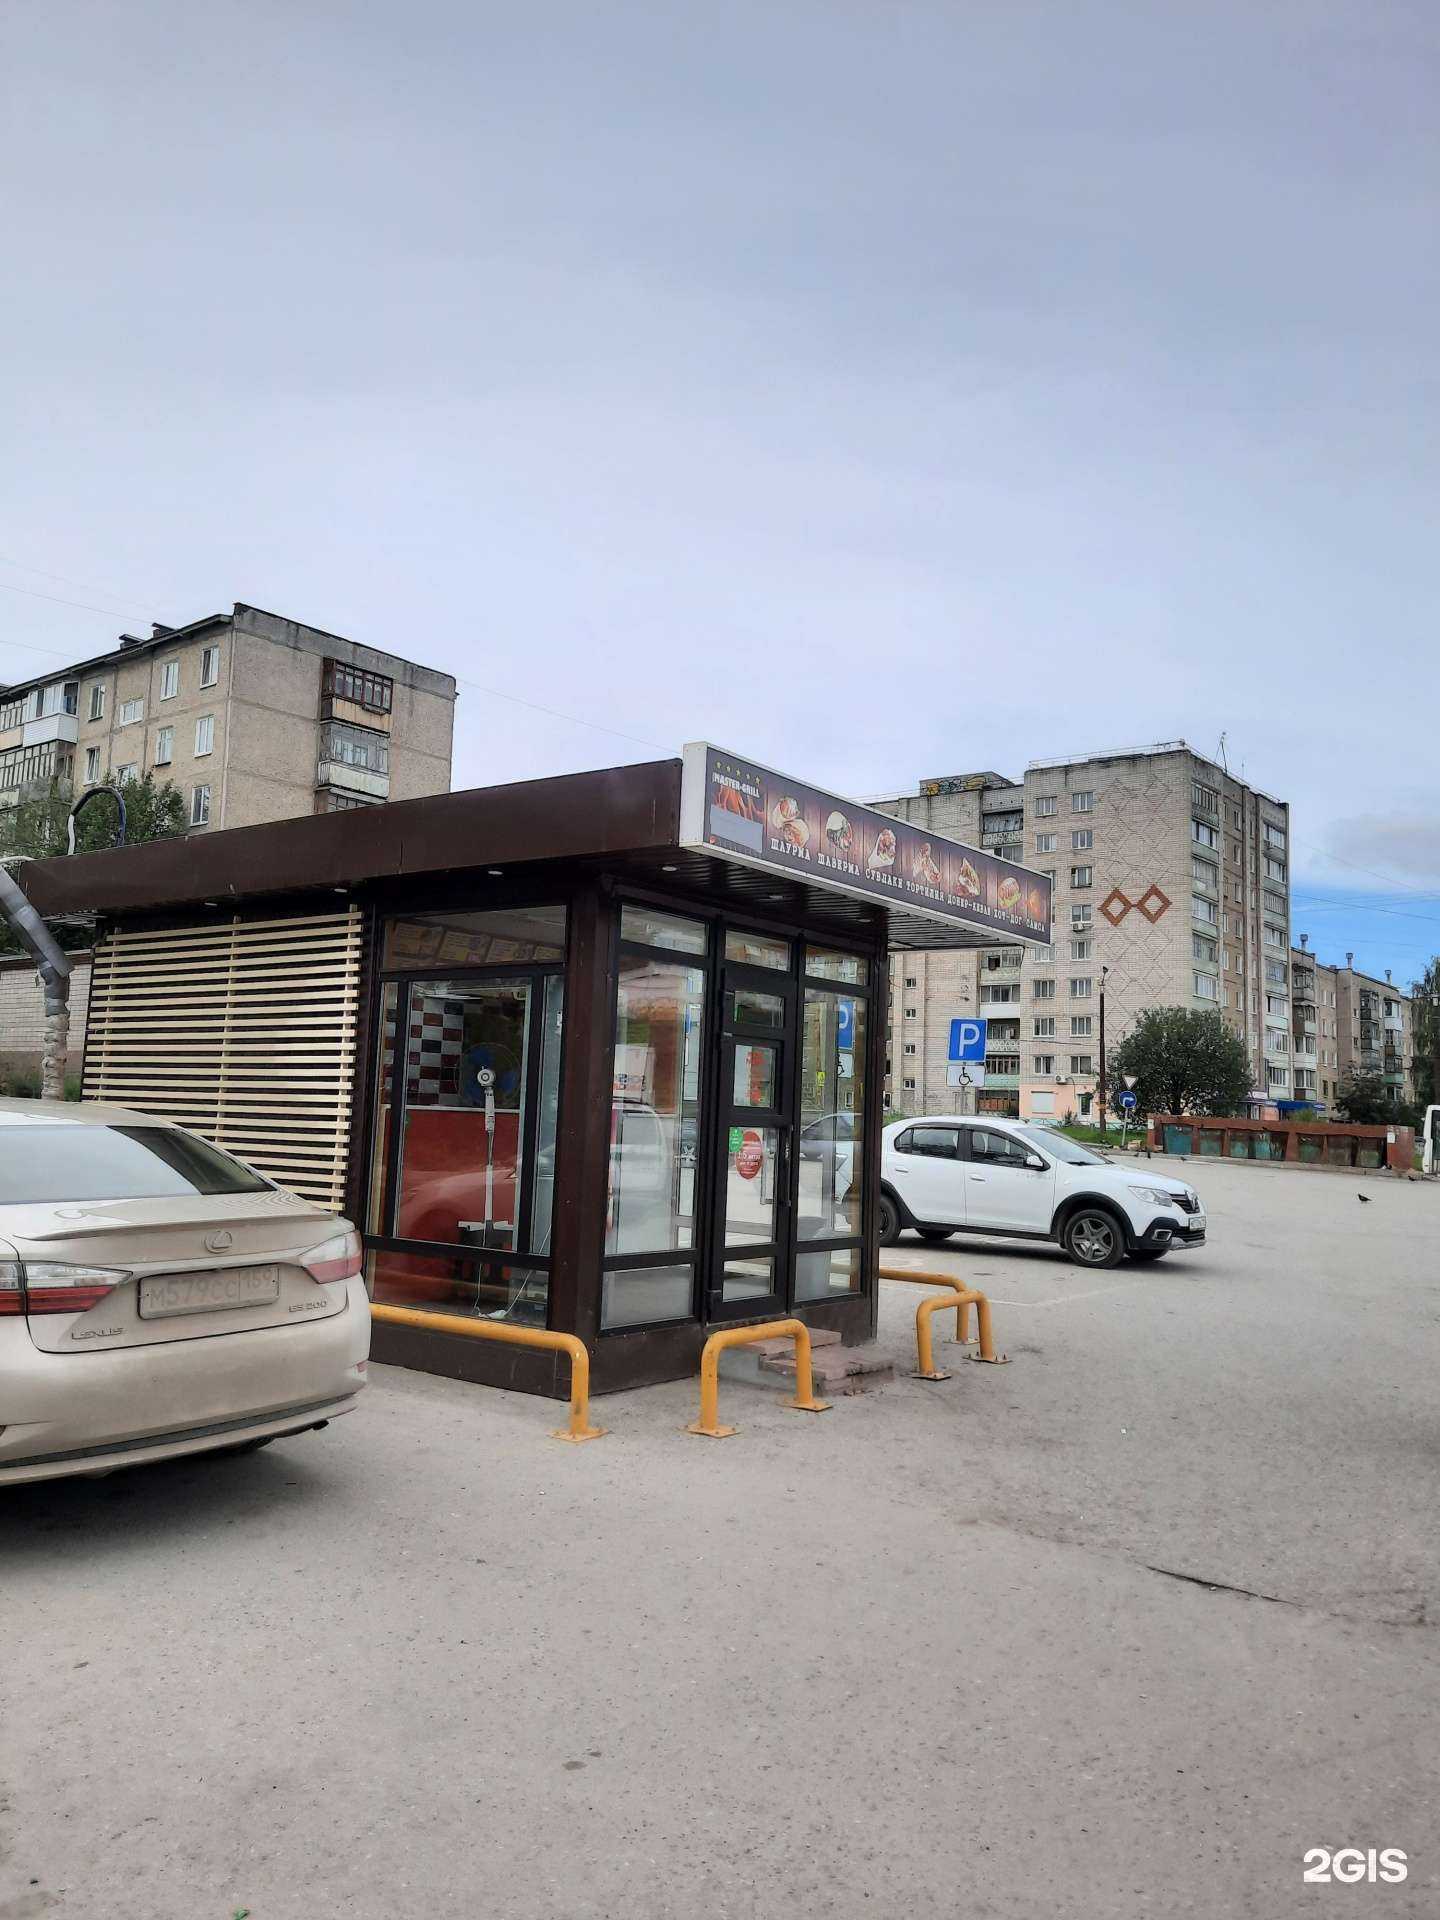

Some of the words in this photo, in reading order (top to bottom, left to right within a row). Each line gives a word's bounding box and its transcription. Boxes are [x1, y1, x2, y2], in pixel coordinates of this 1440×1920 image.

[712, 772, 760, 798] MASTER-GRILL
[771, 838, 811, 861] ШАУРМА
[817, 852, 860, 876] ШАВЕРМА
[865, 868, 903, 889] СУВЛАКИ
[993, 908, 1022, 926] ХОТ-ДОГ
[959, 1023, 980, 1057] P
[71, 1327, 125, 1340] LEXUS
